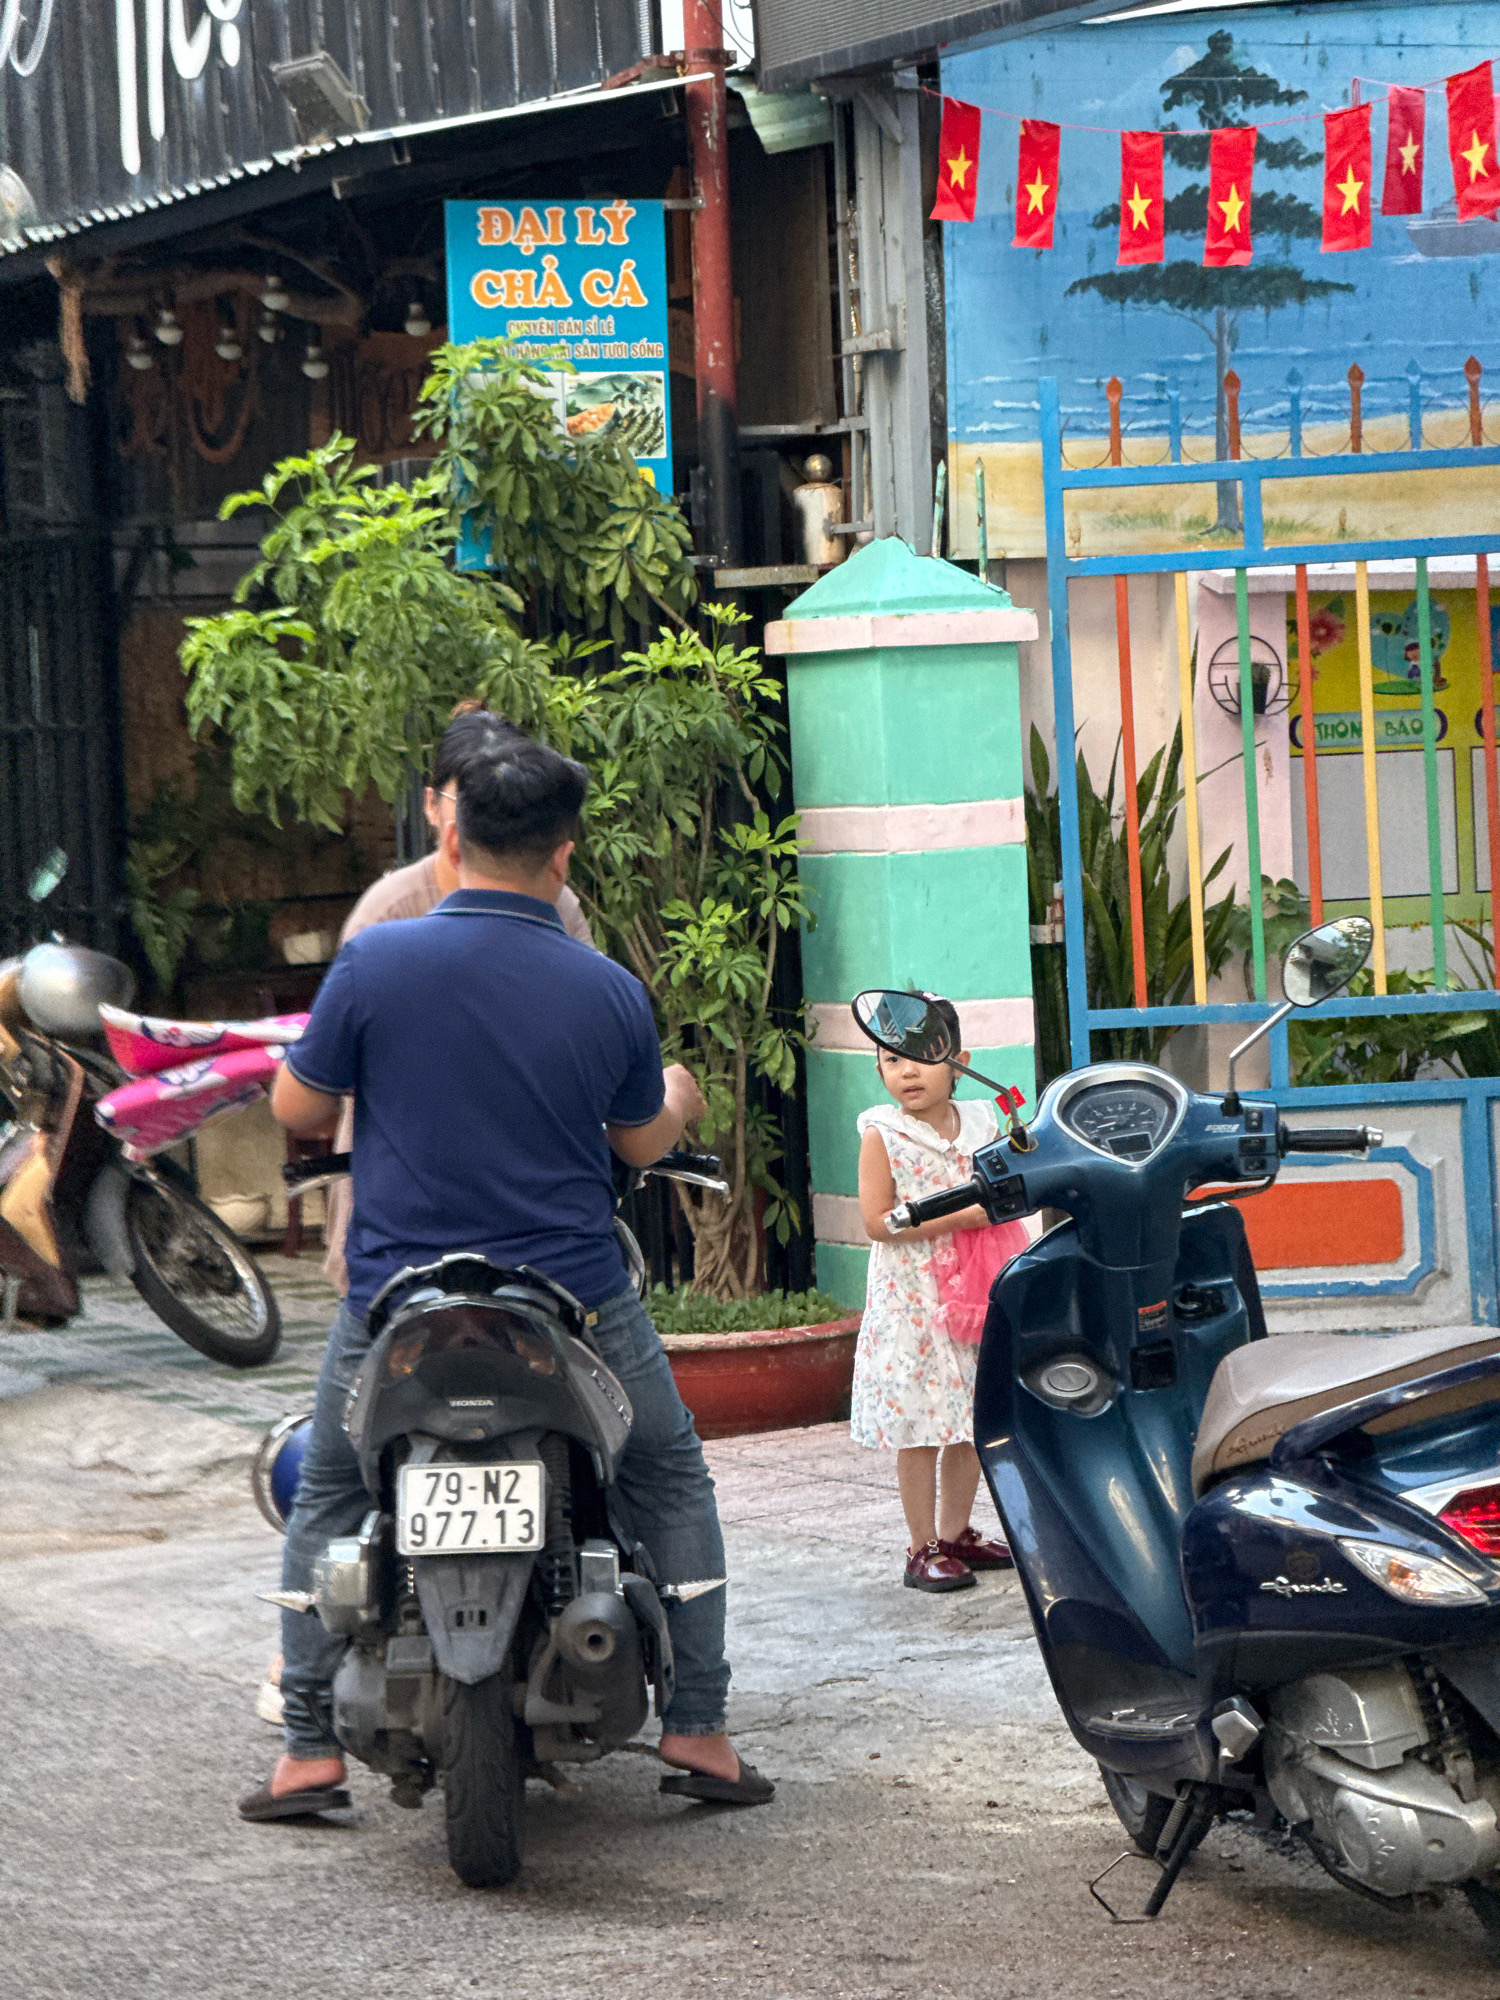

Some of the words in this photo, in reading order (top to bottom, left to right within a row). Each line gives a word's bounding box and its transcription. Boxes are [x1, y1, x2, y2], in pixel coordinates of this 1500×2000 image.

[477, 207, 566, 255] ĐẠI
[574, 199, 636, 246] LÝ
[470, 254, 573, 308] CHẢ
[580, 258, 648, 307] CÁ
[557, 316, 583, 336] BÁN
[630, 337, 664, 358] SỐNG
[1315, 719, 1363, 741] THÔN
[449, 1399, 495, 1407] HONDA
[425, 1469, 521, 1506] 79-N2
[410, 1508, 534, 1547] 977.13
